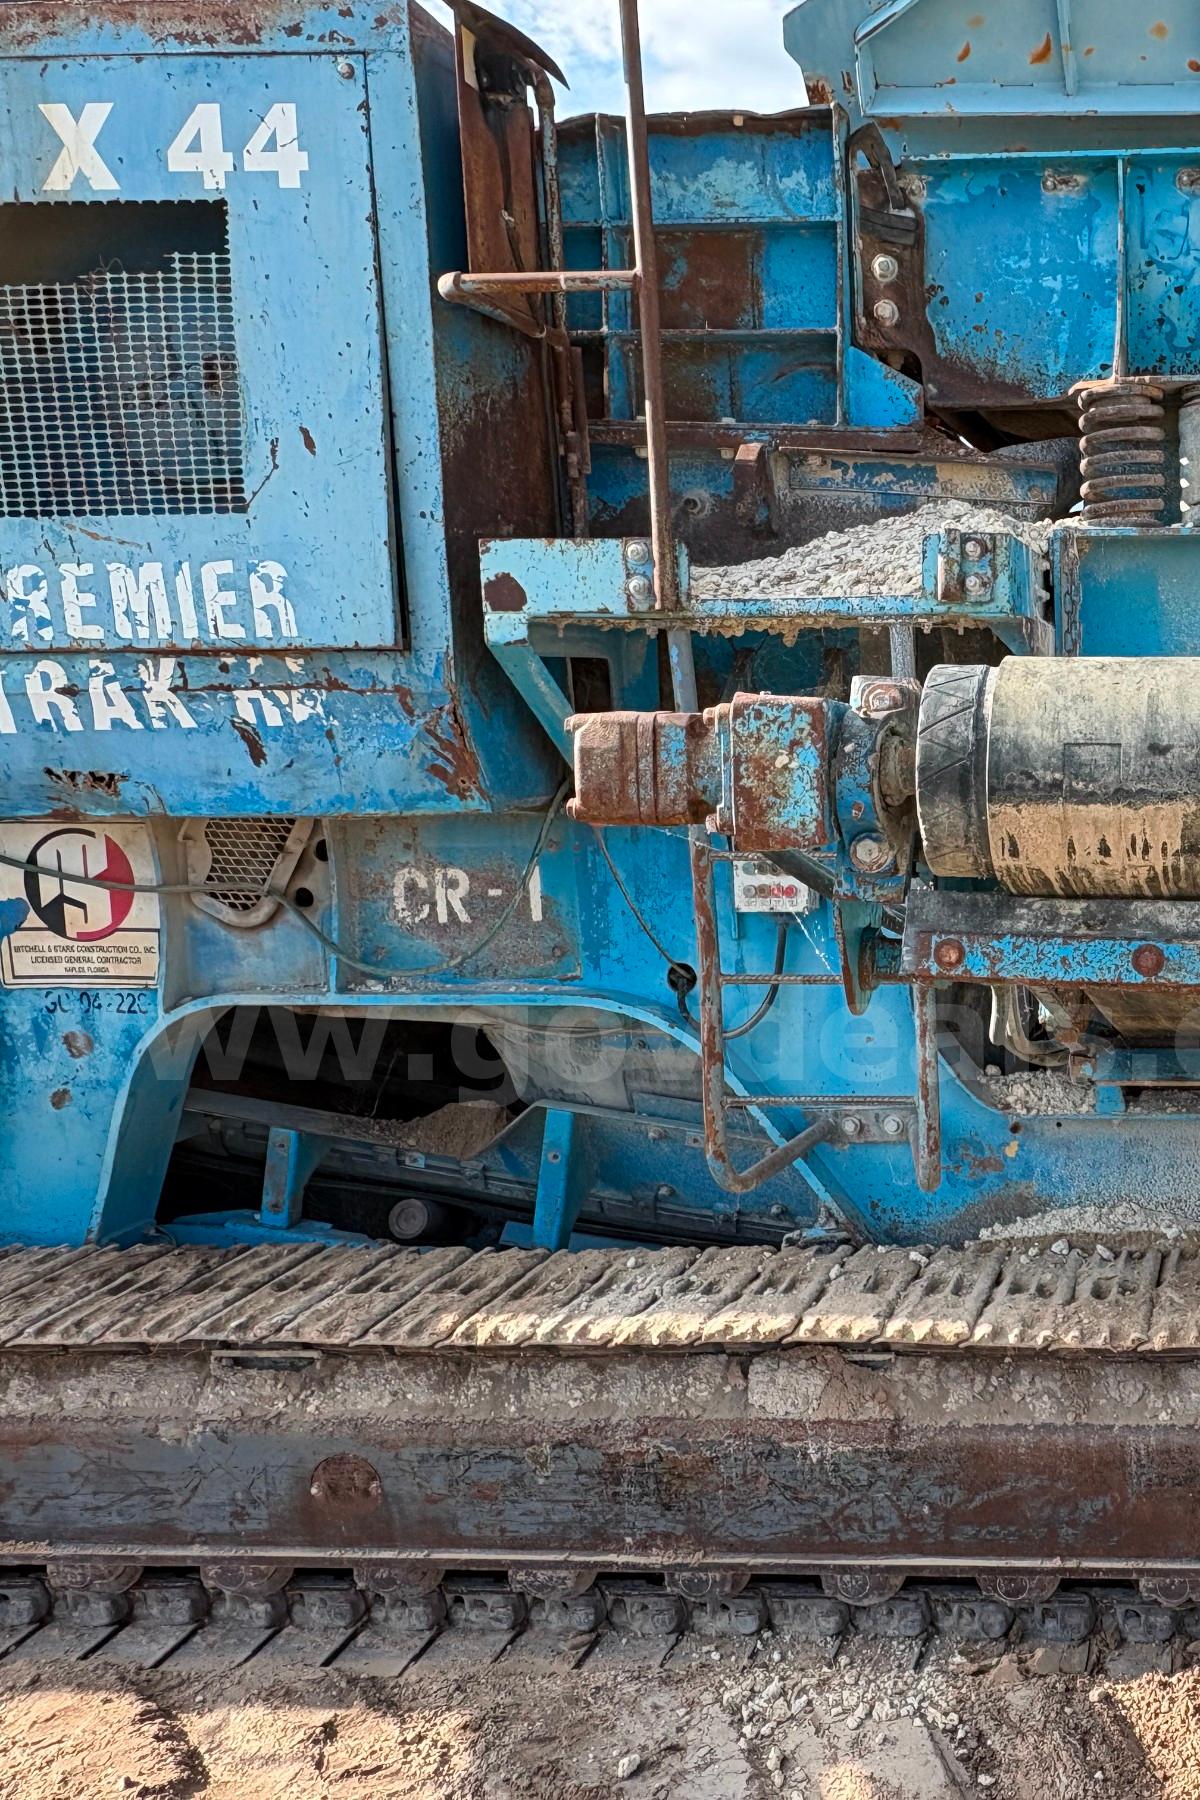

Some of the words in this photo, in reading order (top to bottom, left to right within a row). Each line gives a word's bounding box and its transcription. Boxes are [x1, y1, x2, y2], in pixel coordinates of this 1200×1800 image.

[39, 103, 121, 191] X
[167, 103, 310, 189] 44
[96, 956, 142, 965] CONTRACTOR
